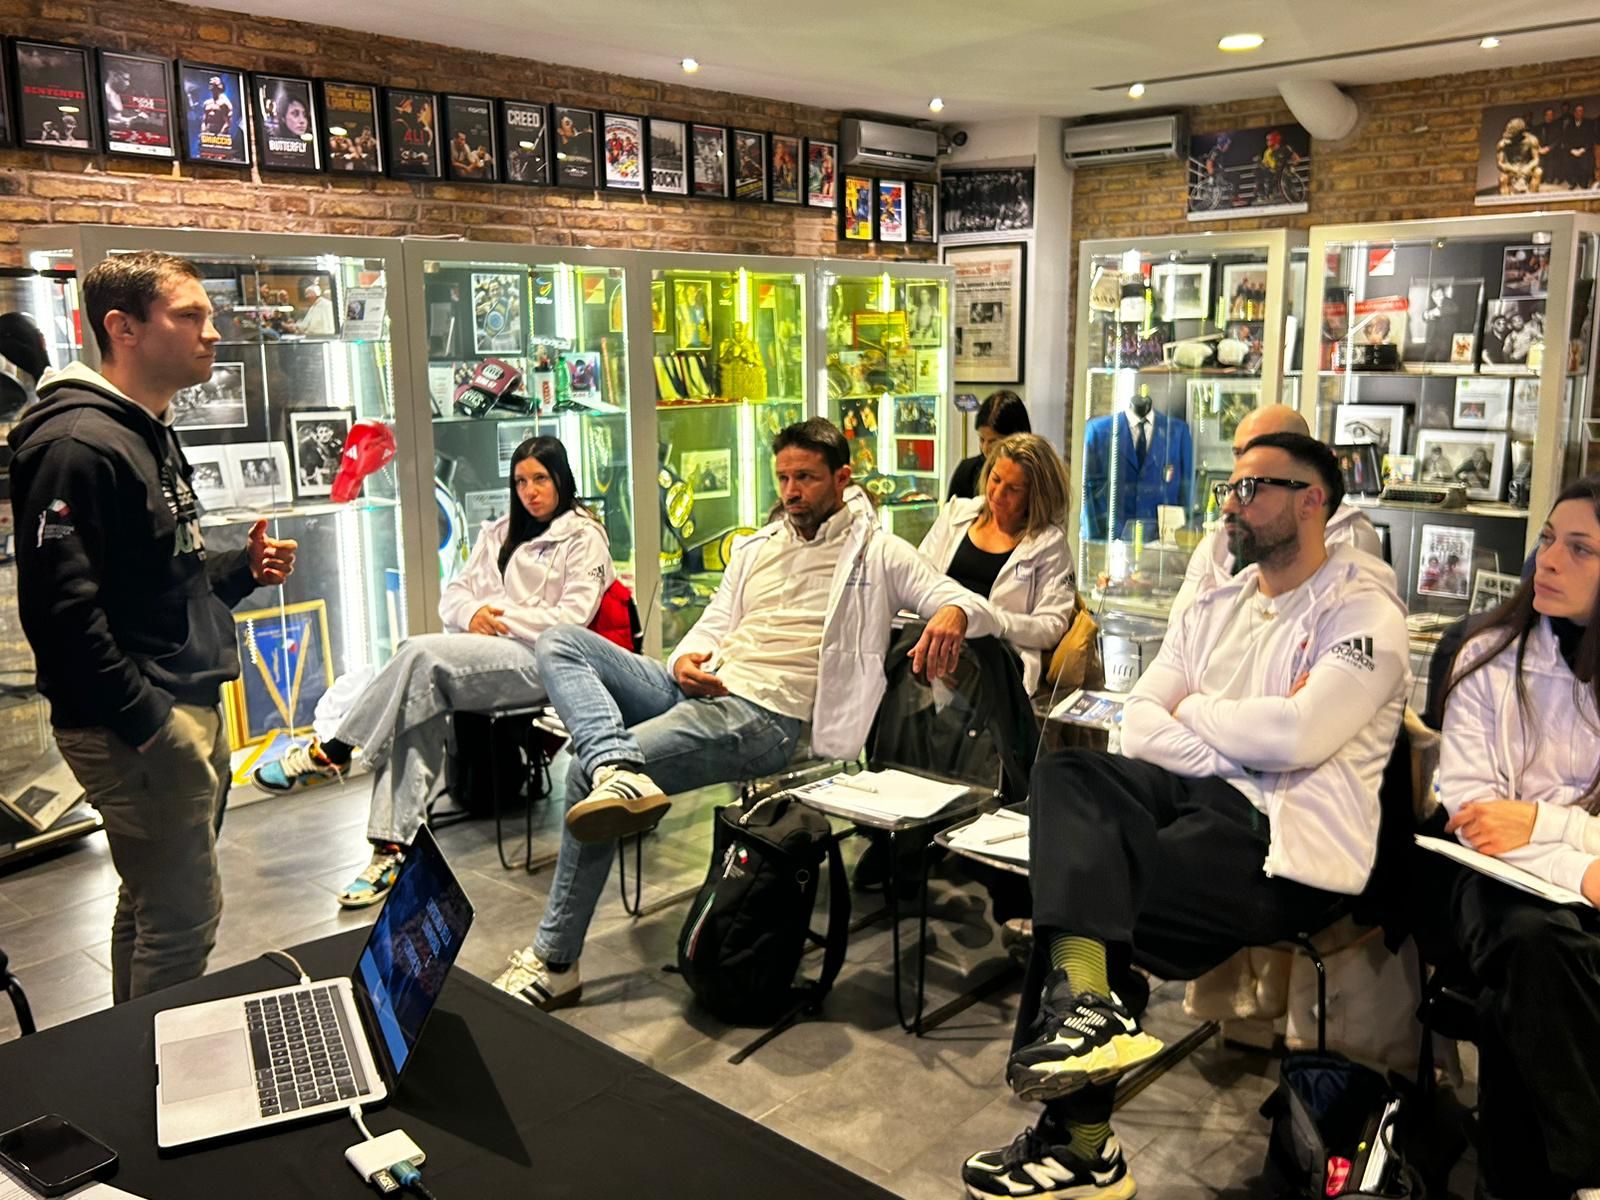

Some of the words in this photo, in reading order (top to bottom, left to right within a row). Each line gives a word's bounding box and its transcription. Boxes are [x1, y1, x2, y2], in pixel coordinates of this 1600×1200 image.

[506, 110, 541, 128] CREED
[404, 128, 425, 145] ALI
[268, 140, 307, 153] BUTTERFLY
[652, 170, 683, 188] ROCKY
[1331, 645, 1375, 672] adidas
